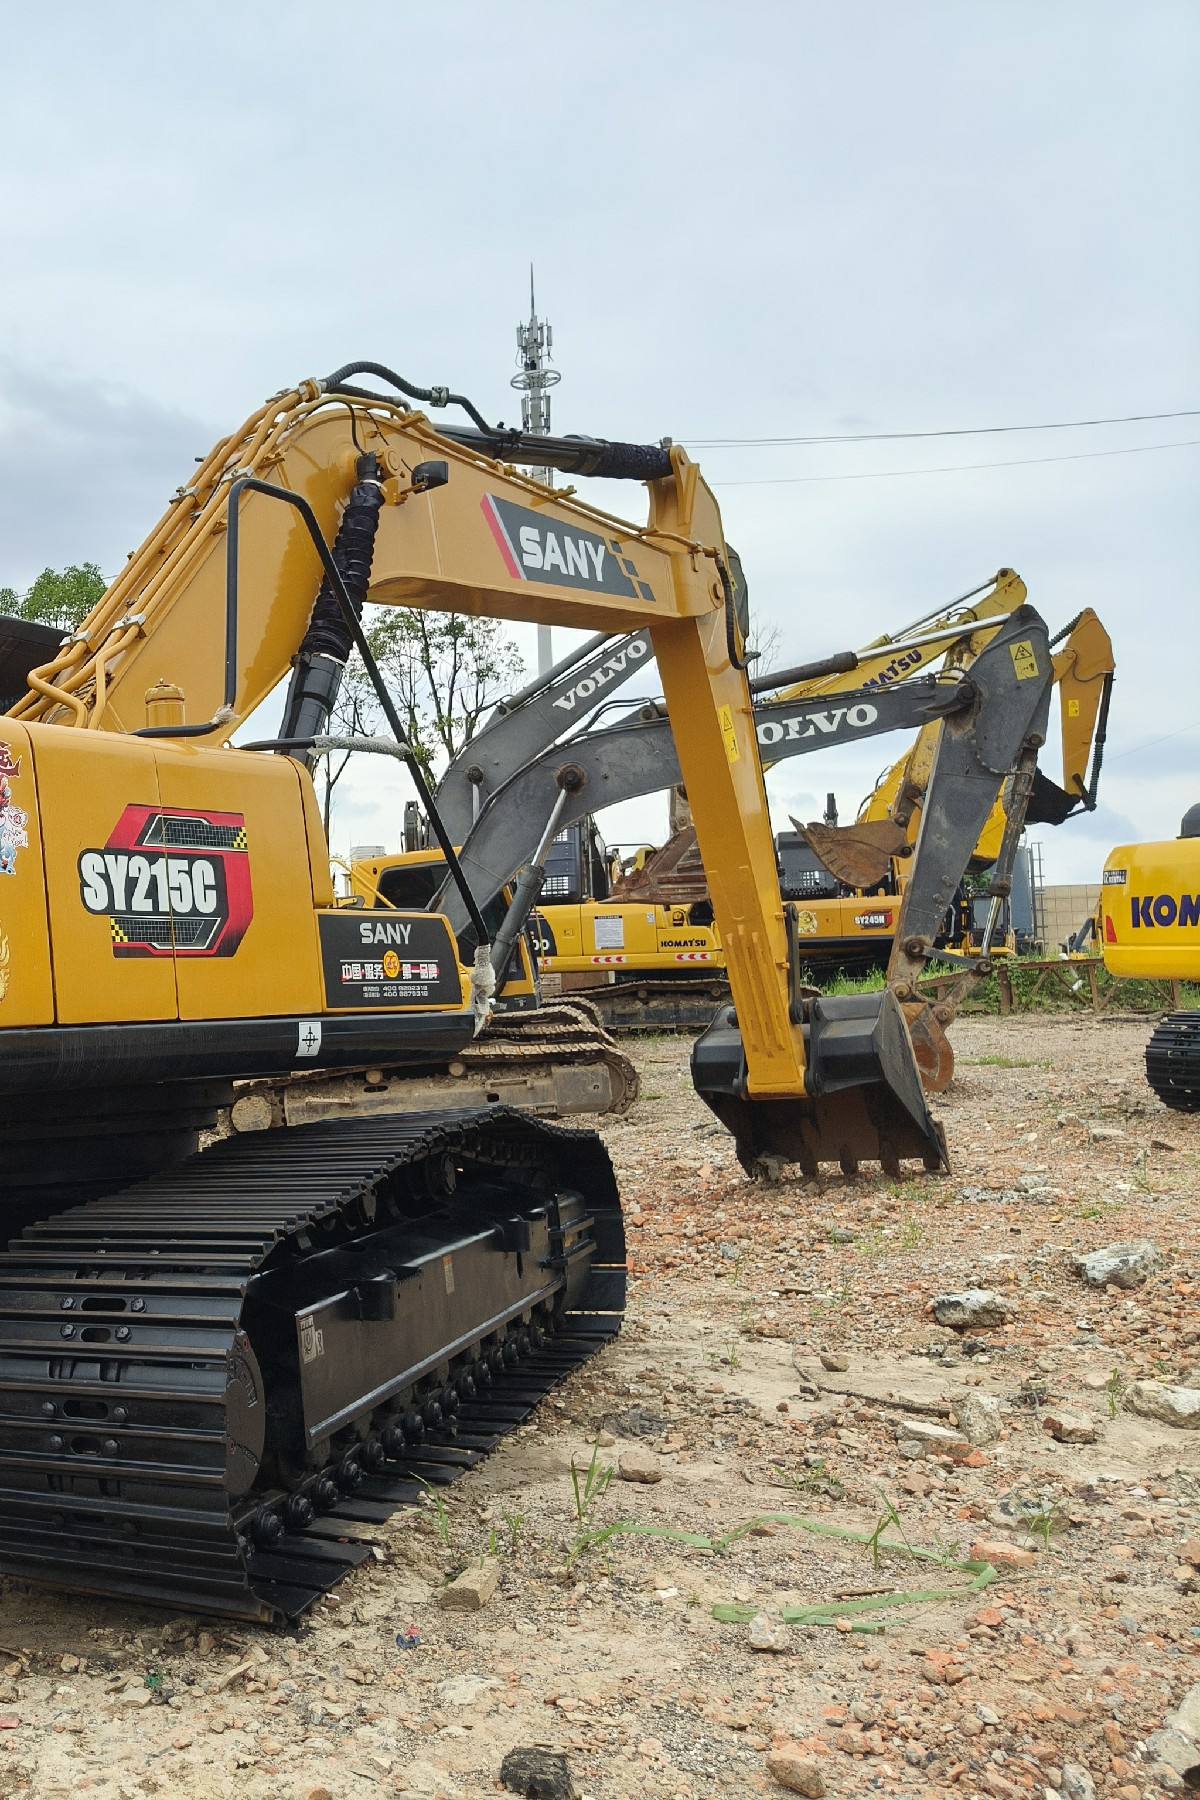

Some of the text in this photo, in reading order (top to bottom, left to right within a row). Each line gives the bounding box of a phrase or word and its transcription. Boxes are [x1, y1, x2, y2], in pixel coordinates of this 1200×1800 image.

[519, 526, 605, 582] SANY
[553, 639, 648, 711] VOLVO
[863, 649, 923, 689] MATSU
[756, 704, 878, 745] OLVO
[80, 851, 217, 914] SY215C
[1131, 894, 1200, 928] KOM
[360, 922, 411, 944] SANY
[660, 938, 707, 948] KOMATSU
